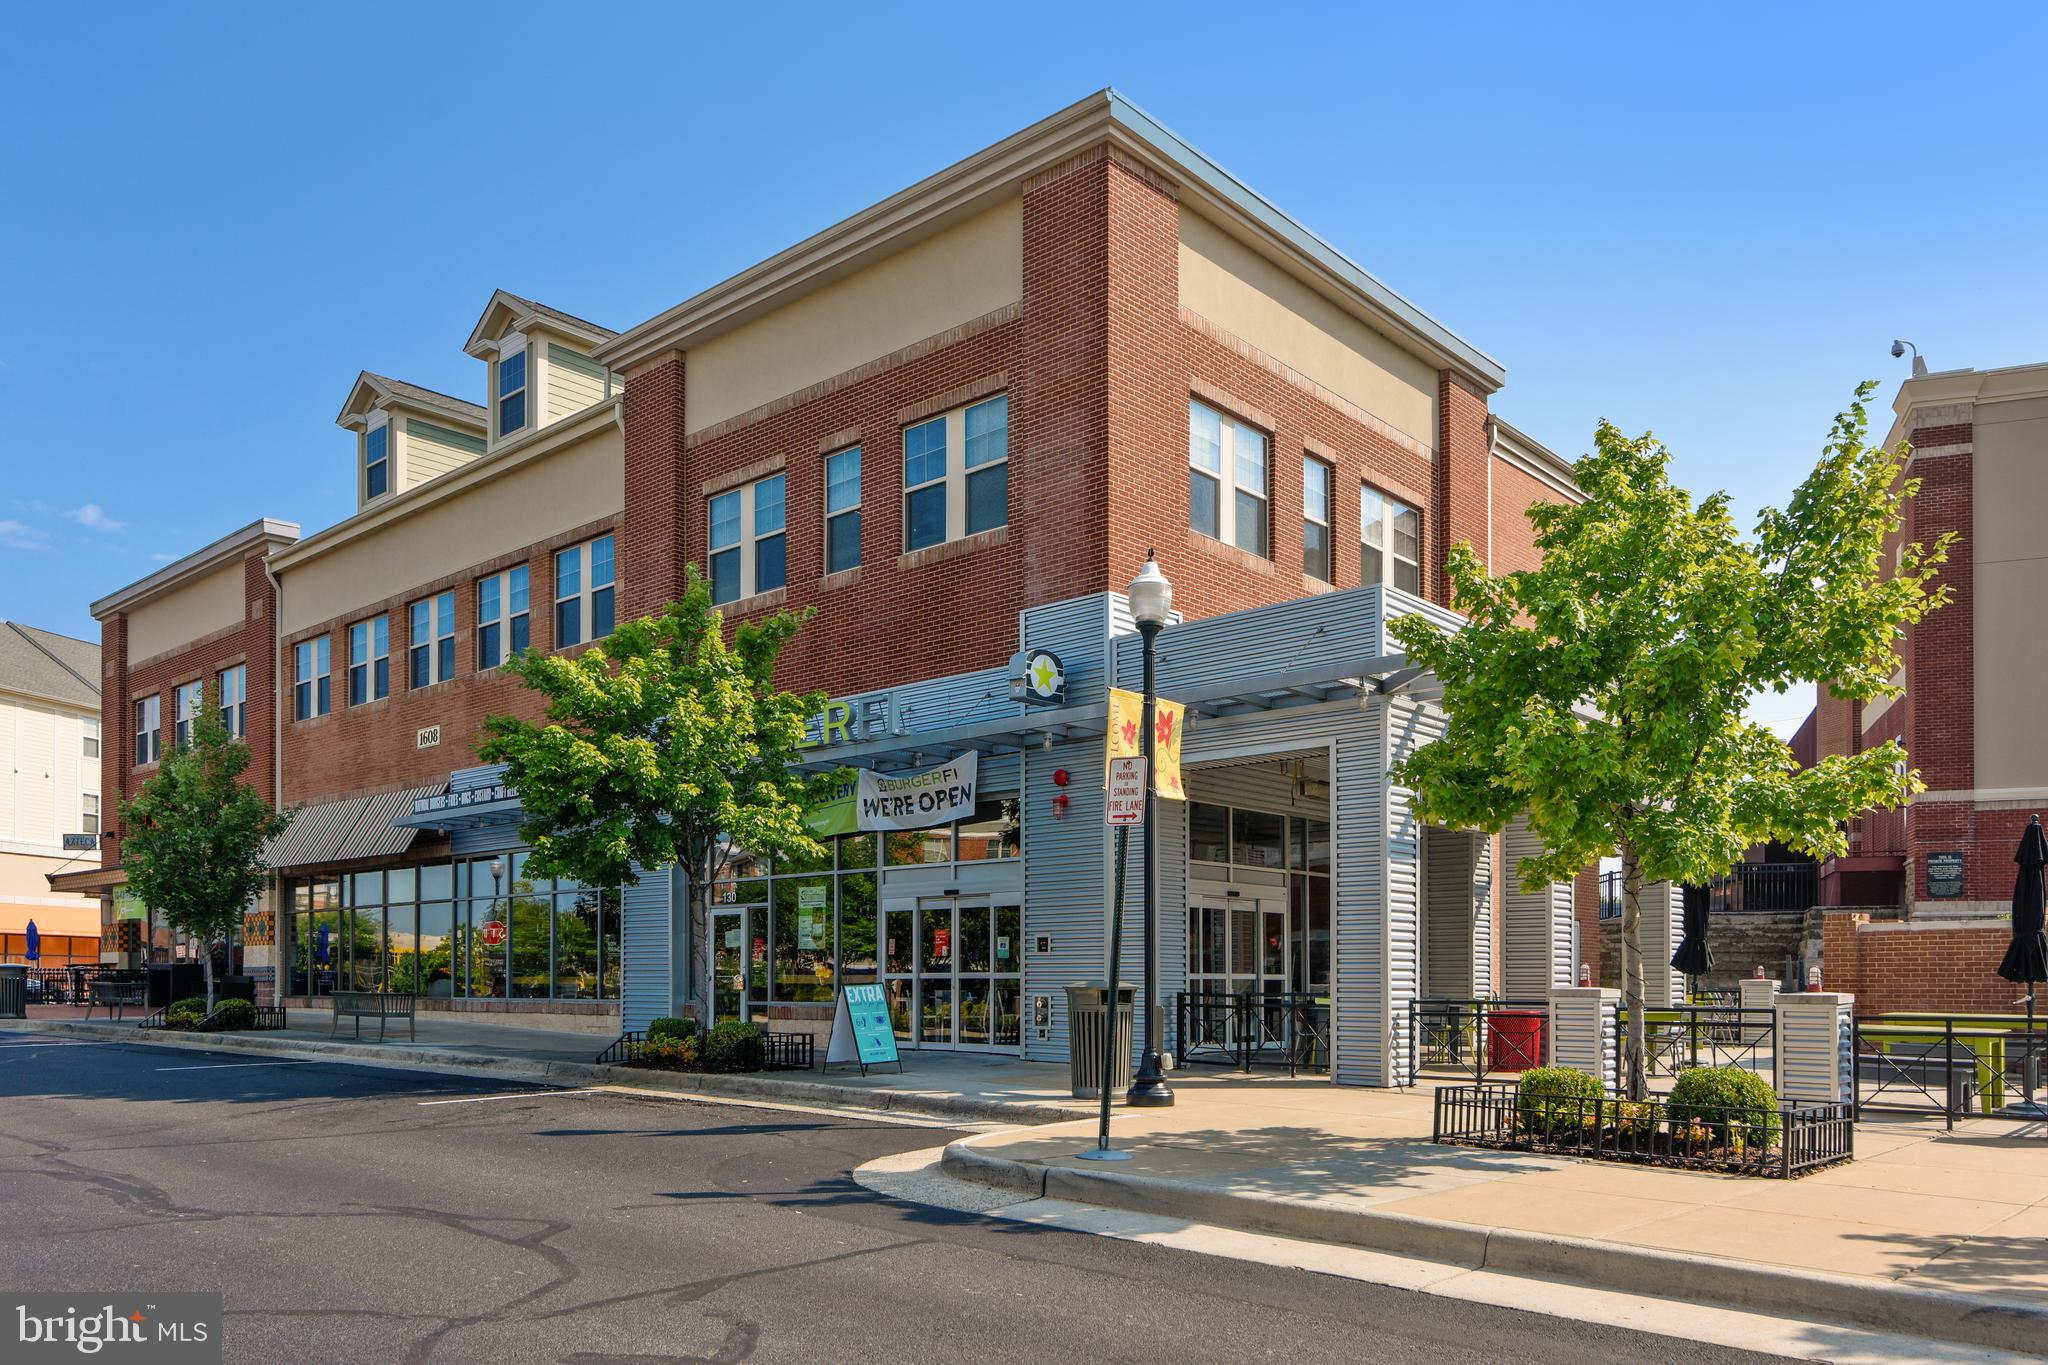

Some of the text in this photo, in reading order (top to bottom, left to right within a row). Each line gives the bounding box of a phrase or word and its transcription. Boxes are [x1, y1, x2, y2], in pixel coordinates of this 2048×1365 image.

[419, 728, 438, 746] 1608
[1122, 760, 1133, 771] NO
[886, 768, 958, 792] BURGERFI
[1115, 771, 1138, 781] PARKING
[1113, 787, 1139, 797] STANDING
[863, 782, 972, 818] WE'RE OPEN
[1109, 799, 1143, 811] FIRE LANE
[65, 837, 97, 846] AZTECA
[722, 892, 737, 903] 130
[845, 985, 885, 1003] EXTRA
